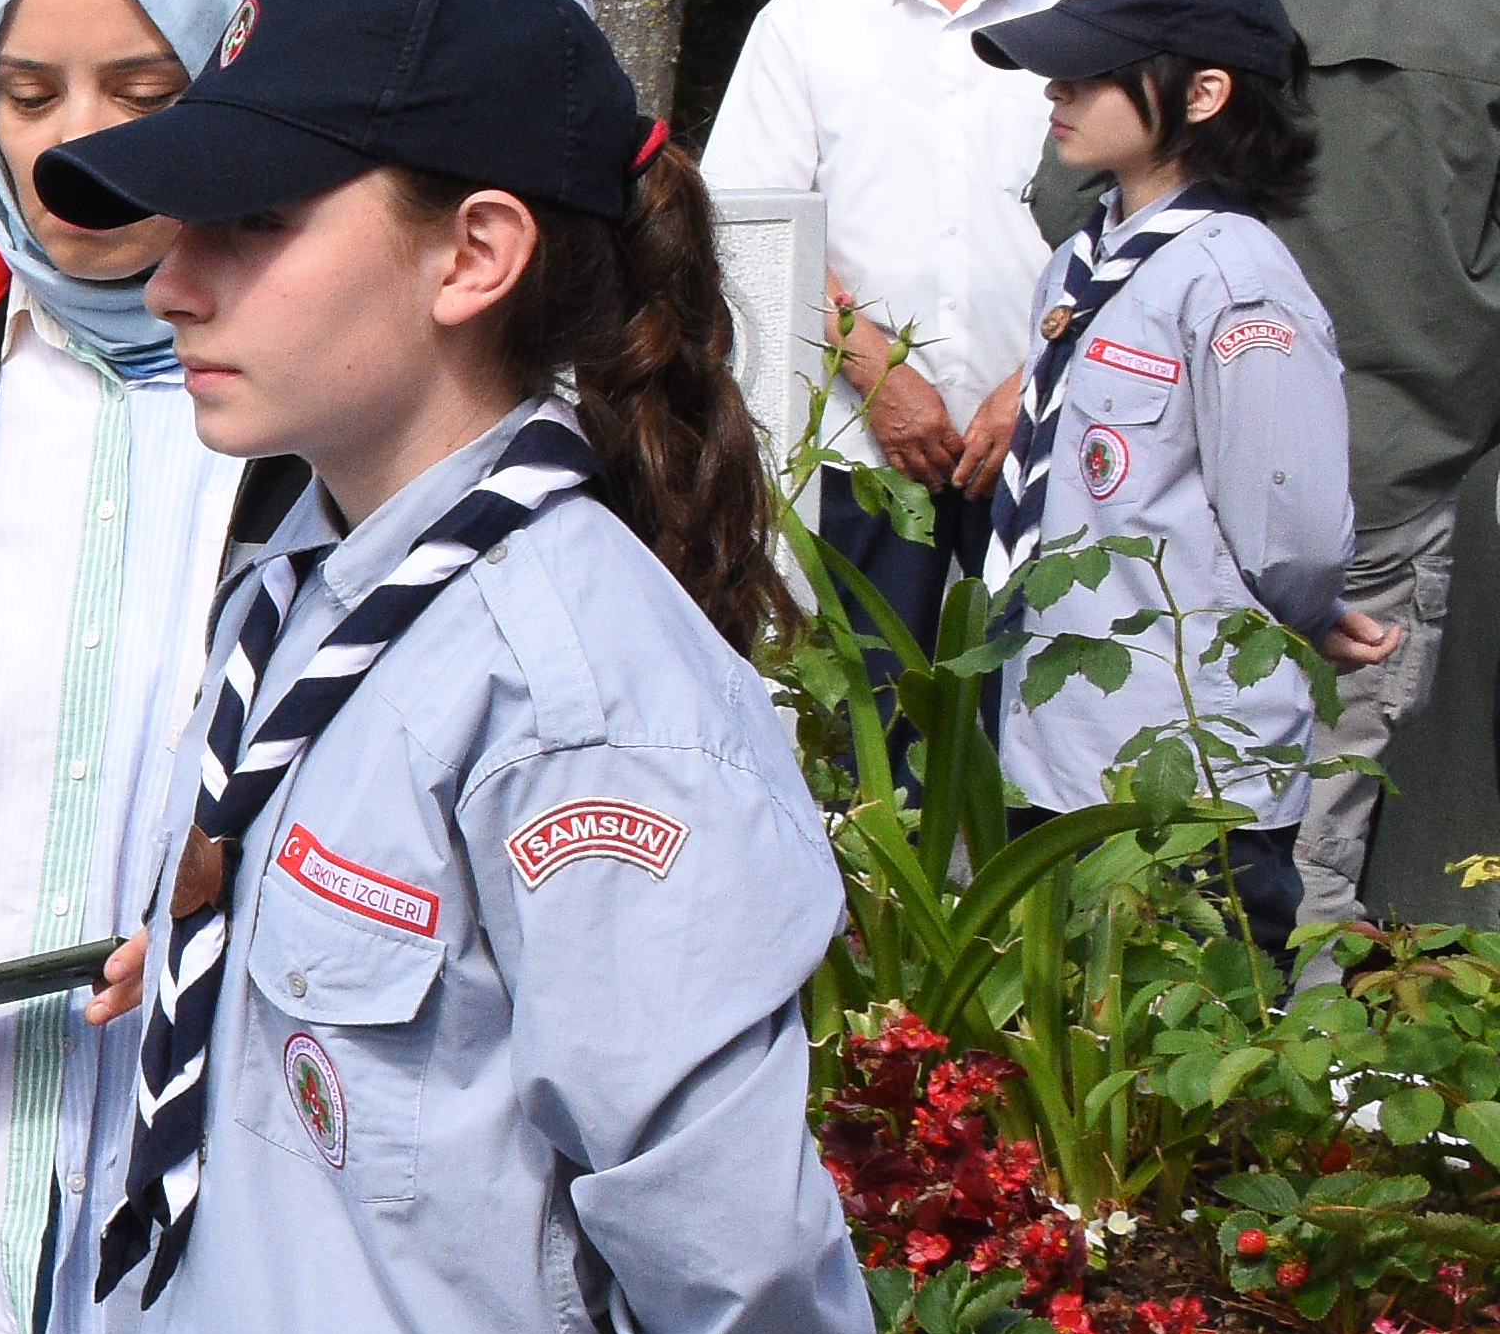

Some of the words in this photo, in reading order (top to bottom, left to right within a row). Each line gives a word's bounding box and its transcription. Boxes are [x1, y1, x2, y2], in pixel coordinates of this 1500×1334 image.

[1222, 326, 1288, 350] SAMSUN
[527, 814, 666, 858] SAMSUN
[352, 877, 424, 923] İZCİLERİ
